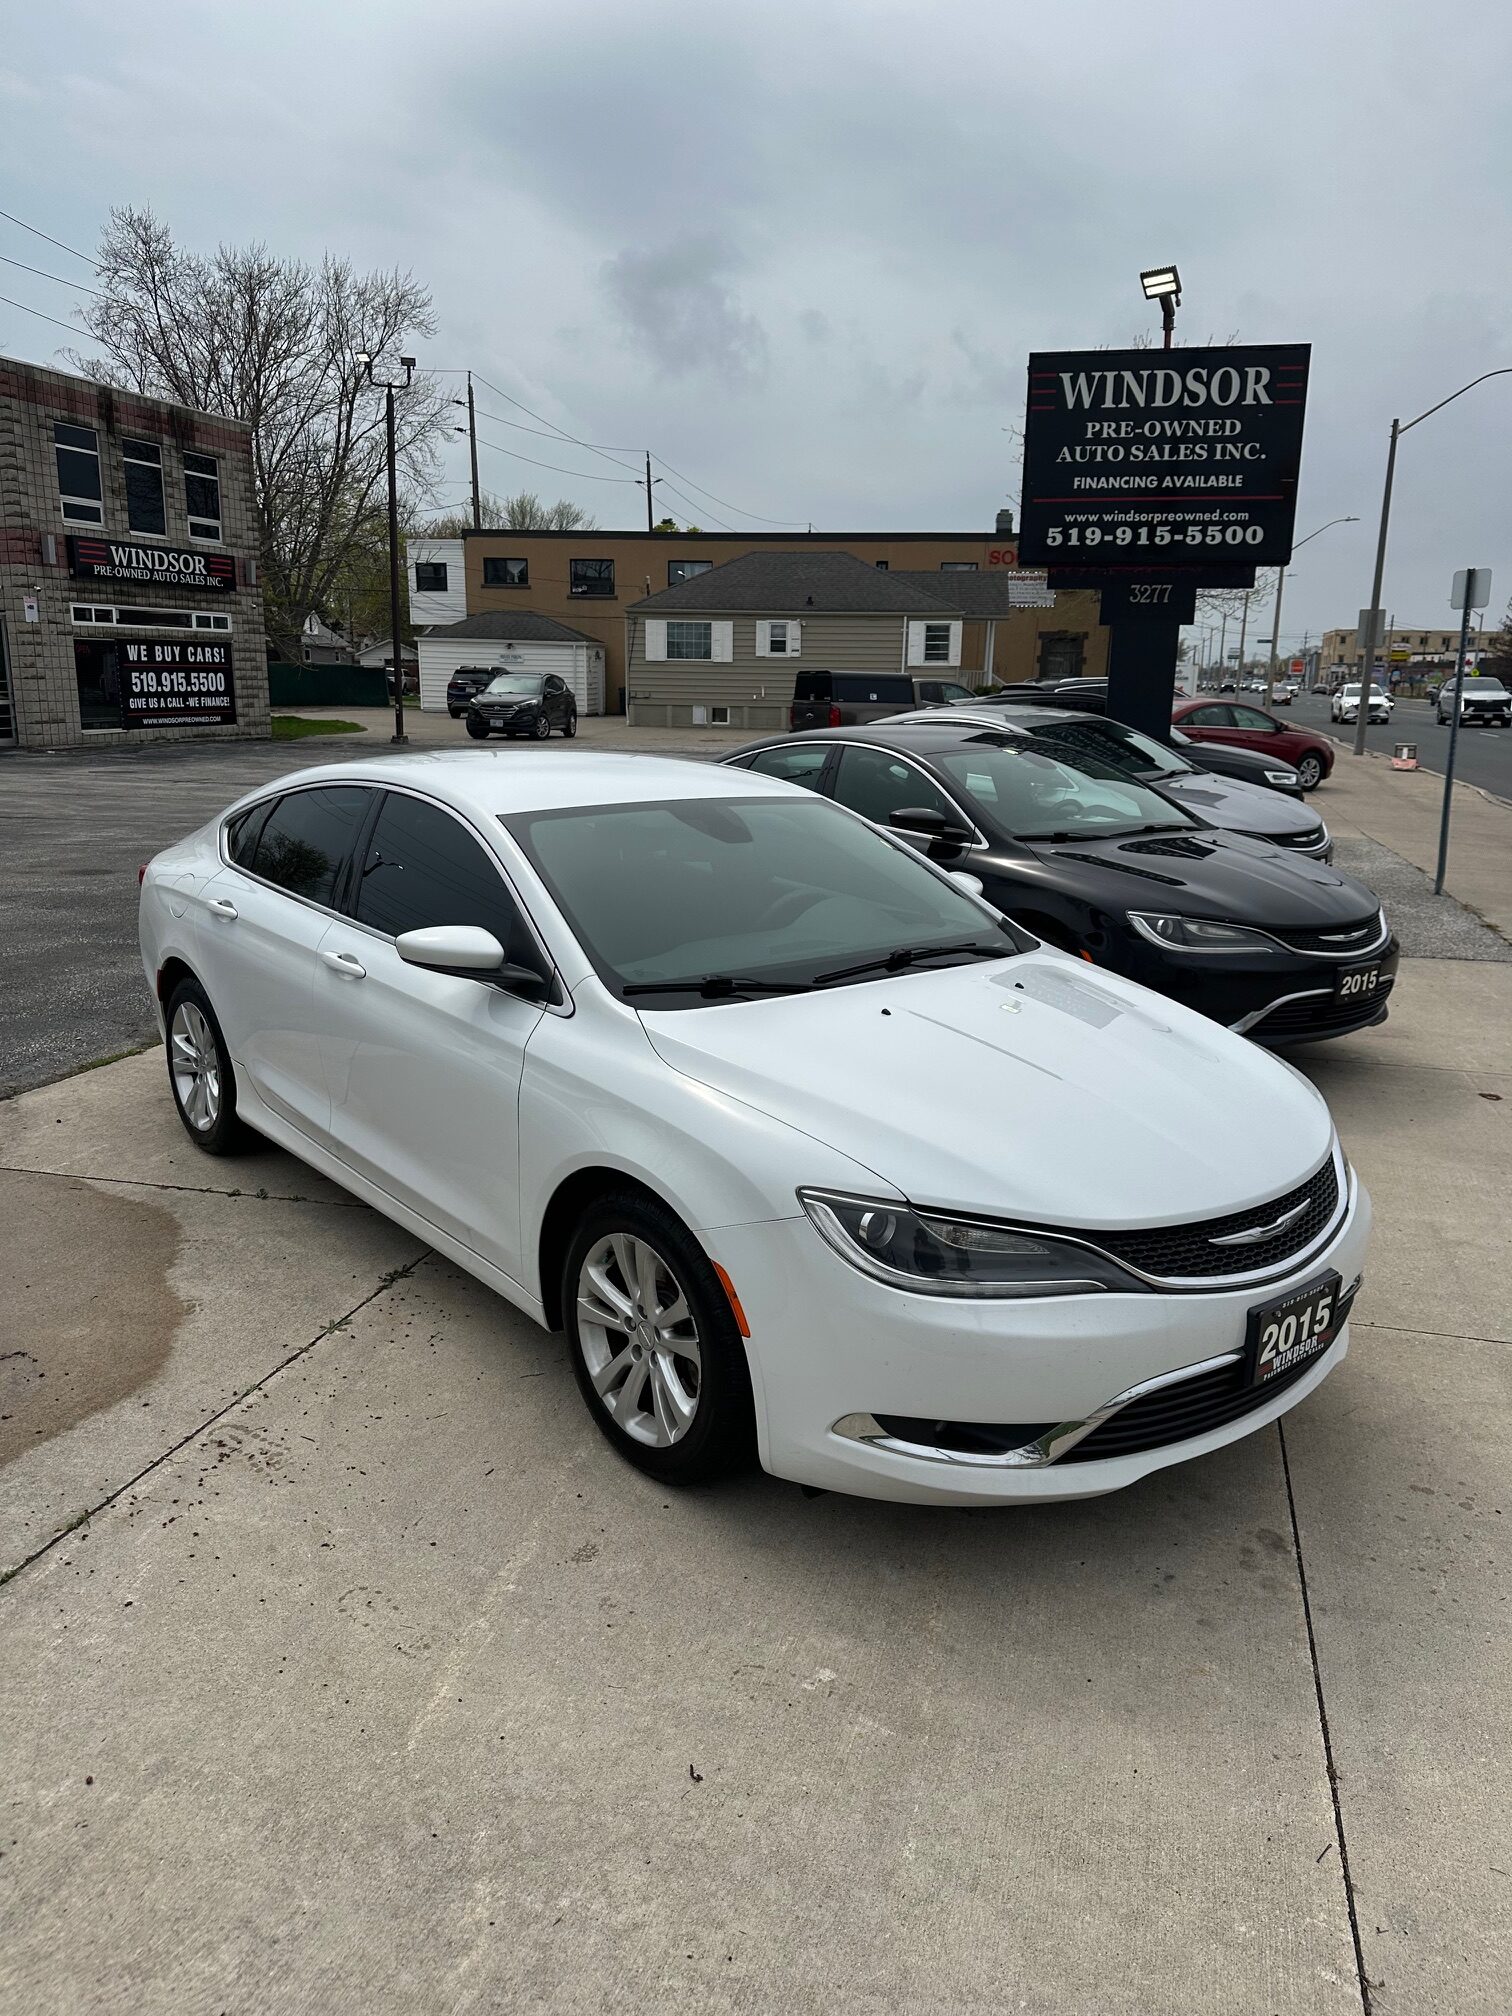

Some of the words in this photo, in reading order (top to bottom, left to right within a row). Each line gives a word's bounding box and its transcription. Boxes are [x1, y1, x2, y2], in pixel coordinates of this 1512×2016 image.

[1059, 366, 1273, 410] WINDSOR
[1085, 419, 1242, 439] PRE-OWNED
[1056, 444, 1125, 463] AUTO
[1130, 443, 1208, 462] SALES
[1213, 442, 1267, 461] INC.
[1073, 476, 1158, 489] FINANCING
[1162, 475, 1244, 488] AVAILABLE
[1046, 525, 1264, 546] 519-915-5500
[110, 545, 207, 575] WINDSOR
[989, 550, 1019, 565] SO
[94, 564, 150, 580] PRE-OWNED
[152, 571, 178, 583] AUTO
[180, 574, 205, 586] SALES
[206, 576, 224, 587] INC.
[1129, 584, 1173, 603] 3277
[127, 645, 147, 661] WE
[155, 645, 180, 662] BUY
[188, 646, 225, 662] CARS!
[131, 671, 225, 692] 519.915.5500
[129, 698, 147, 708] GIVE
[148, 698, 158, 708] US
[160, 698, 166, 708] A
[167, 697, 185, 708] CALL
[201, 696, 230, 707] FINANCE!
[1340, 970, 1378, 995] 2015
[1259, 1295, 1333, 1365] 2015
[1273, 1334, 1318, 1370] WINDSOR
